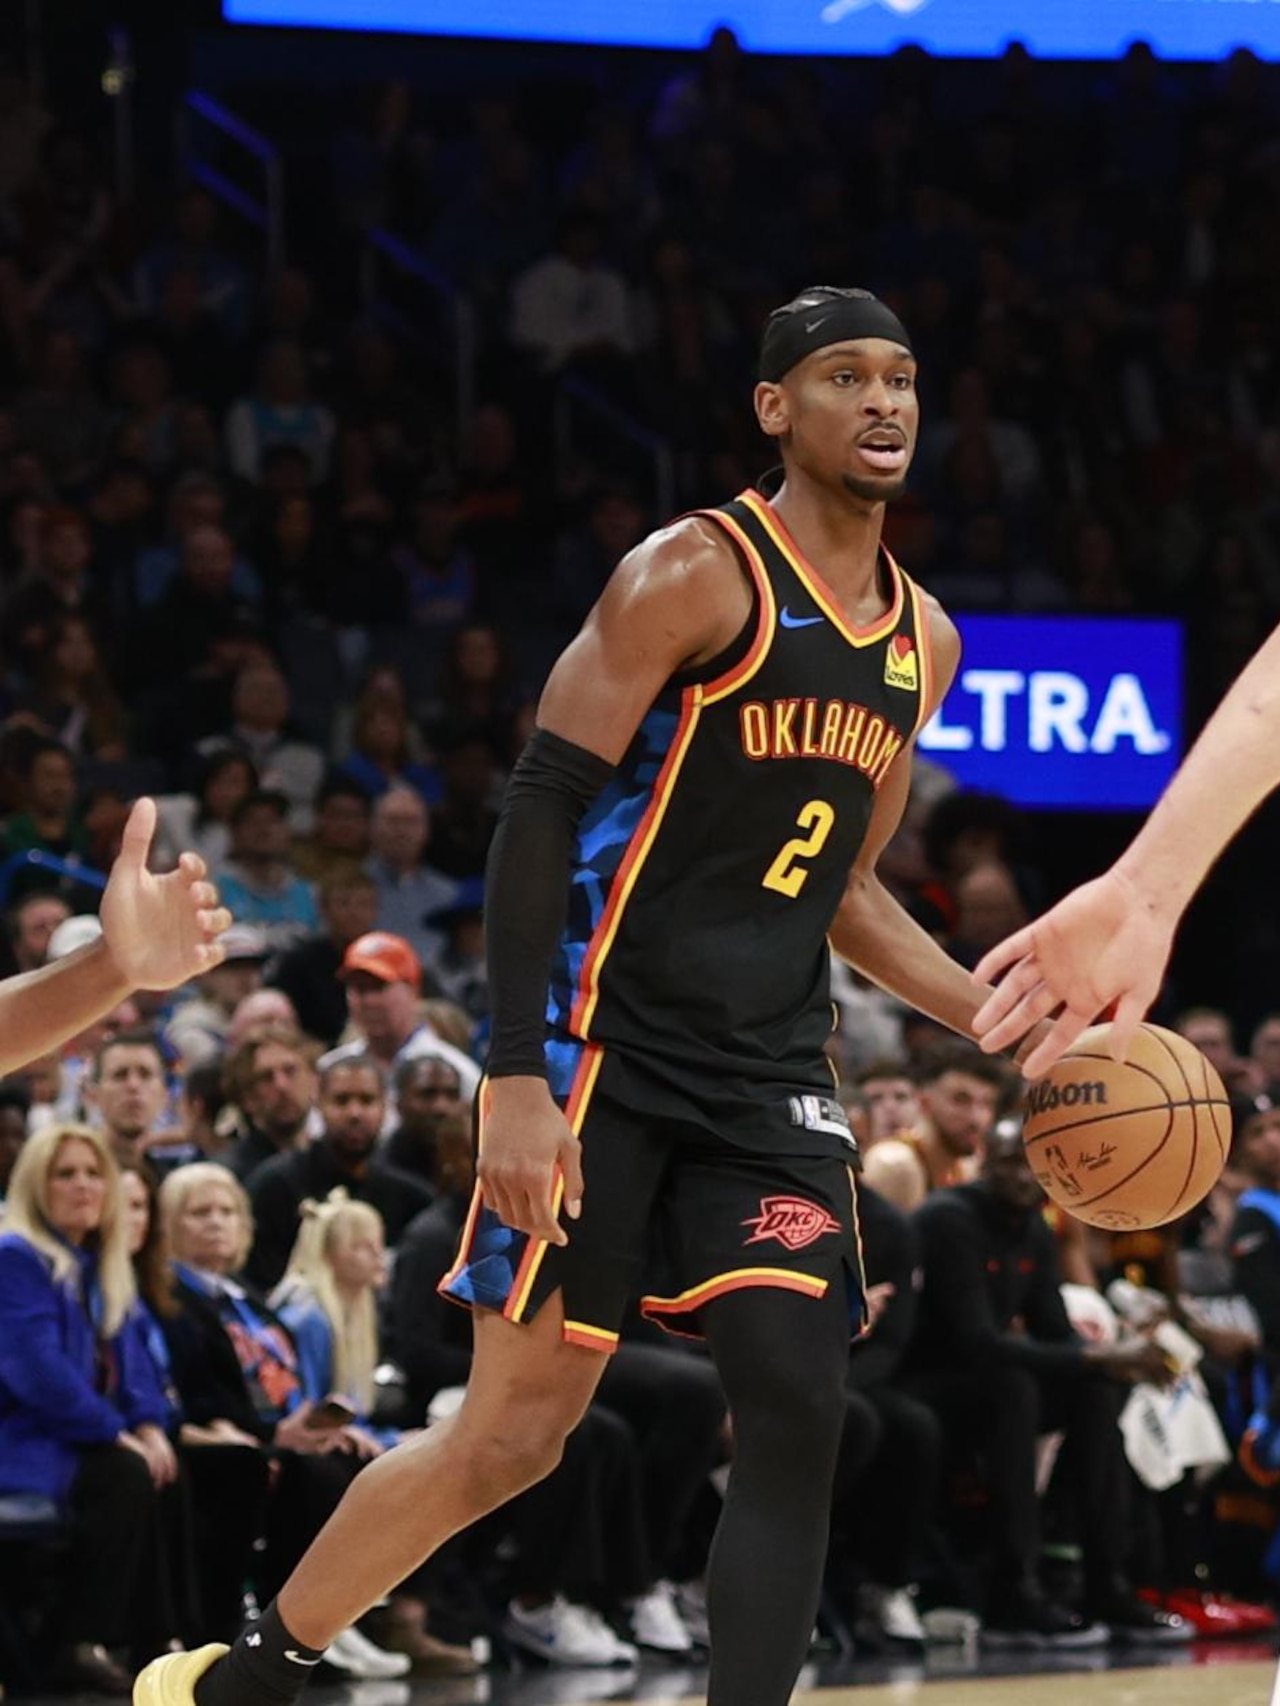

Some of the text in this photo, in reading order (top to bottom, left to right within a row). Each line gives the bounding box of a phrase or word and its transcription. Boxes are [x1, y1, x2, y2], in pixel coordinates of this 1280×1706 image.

[761, 800, 835, 899] 2
[1023, 1079, 1108, 1125] ilson
[760, 1210, 814, 1233] OKC
